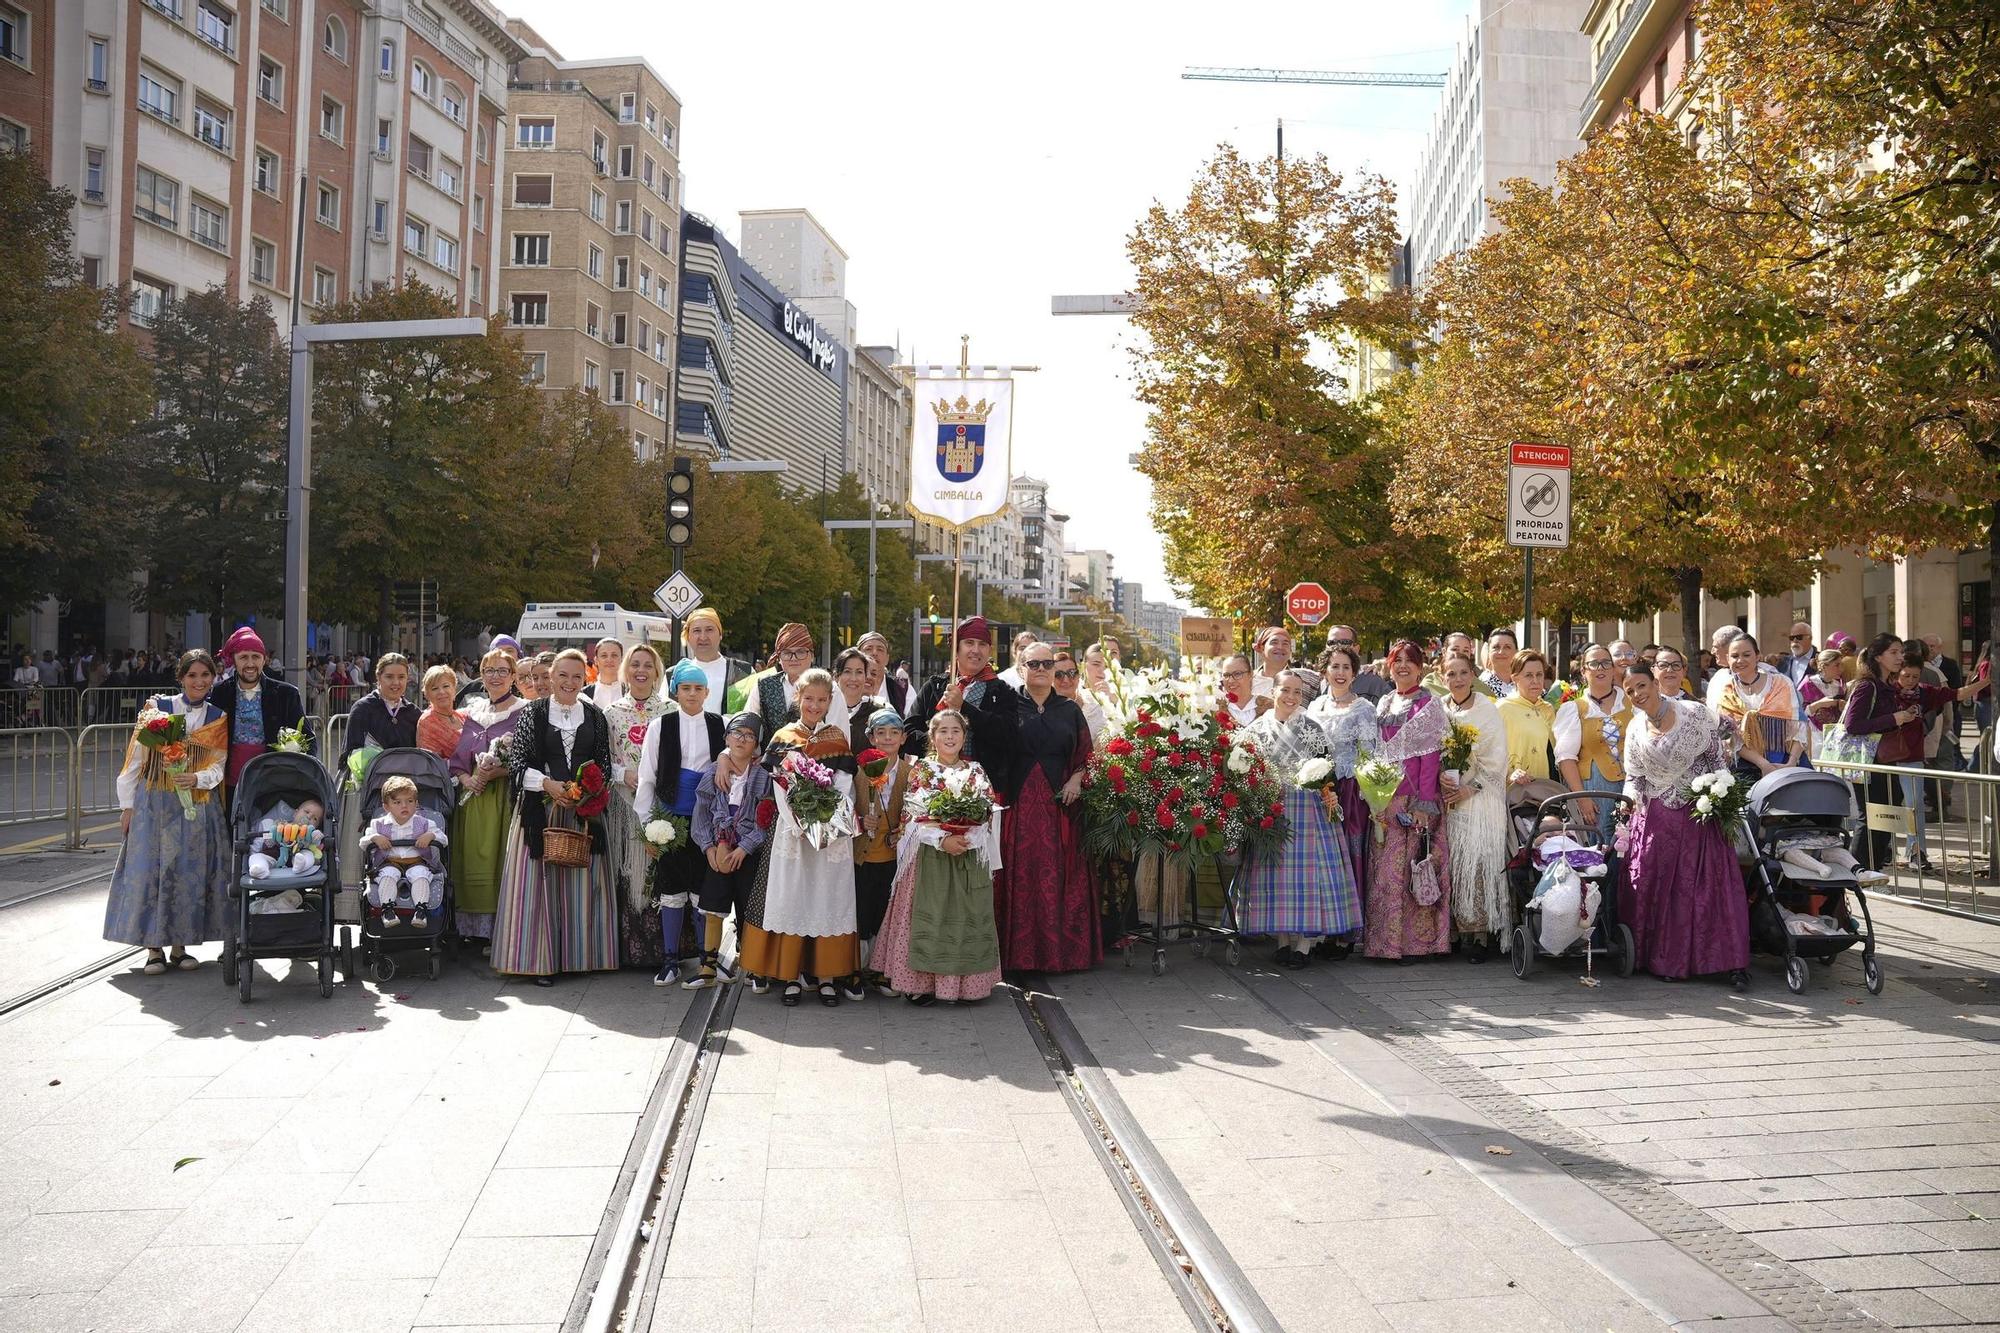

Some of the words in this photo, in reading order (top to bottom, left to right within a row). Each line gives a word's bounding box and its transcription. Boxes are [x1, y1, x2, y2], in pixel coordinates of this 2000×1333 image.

[784, 301, 793, 335] El
[794, 311, 812, 350] Corte
[1518, 451, 1564, 461] ATENCIÓN
[934, 490, 983, 501] CIMBALLA
[1515, 519, 1564, 530] PRIORIDAD
[1516, 531, 1562, 542] PEATONAL
[668, 585, 690, 603] 30
[1291, 598, 1326, 610] STOP
[531, 621, 606, 632] AMBULANCIA
